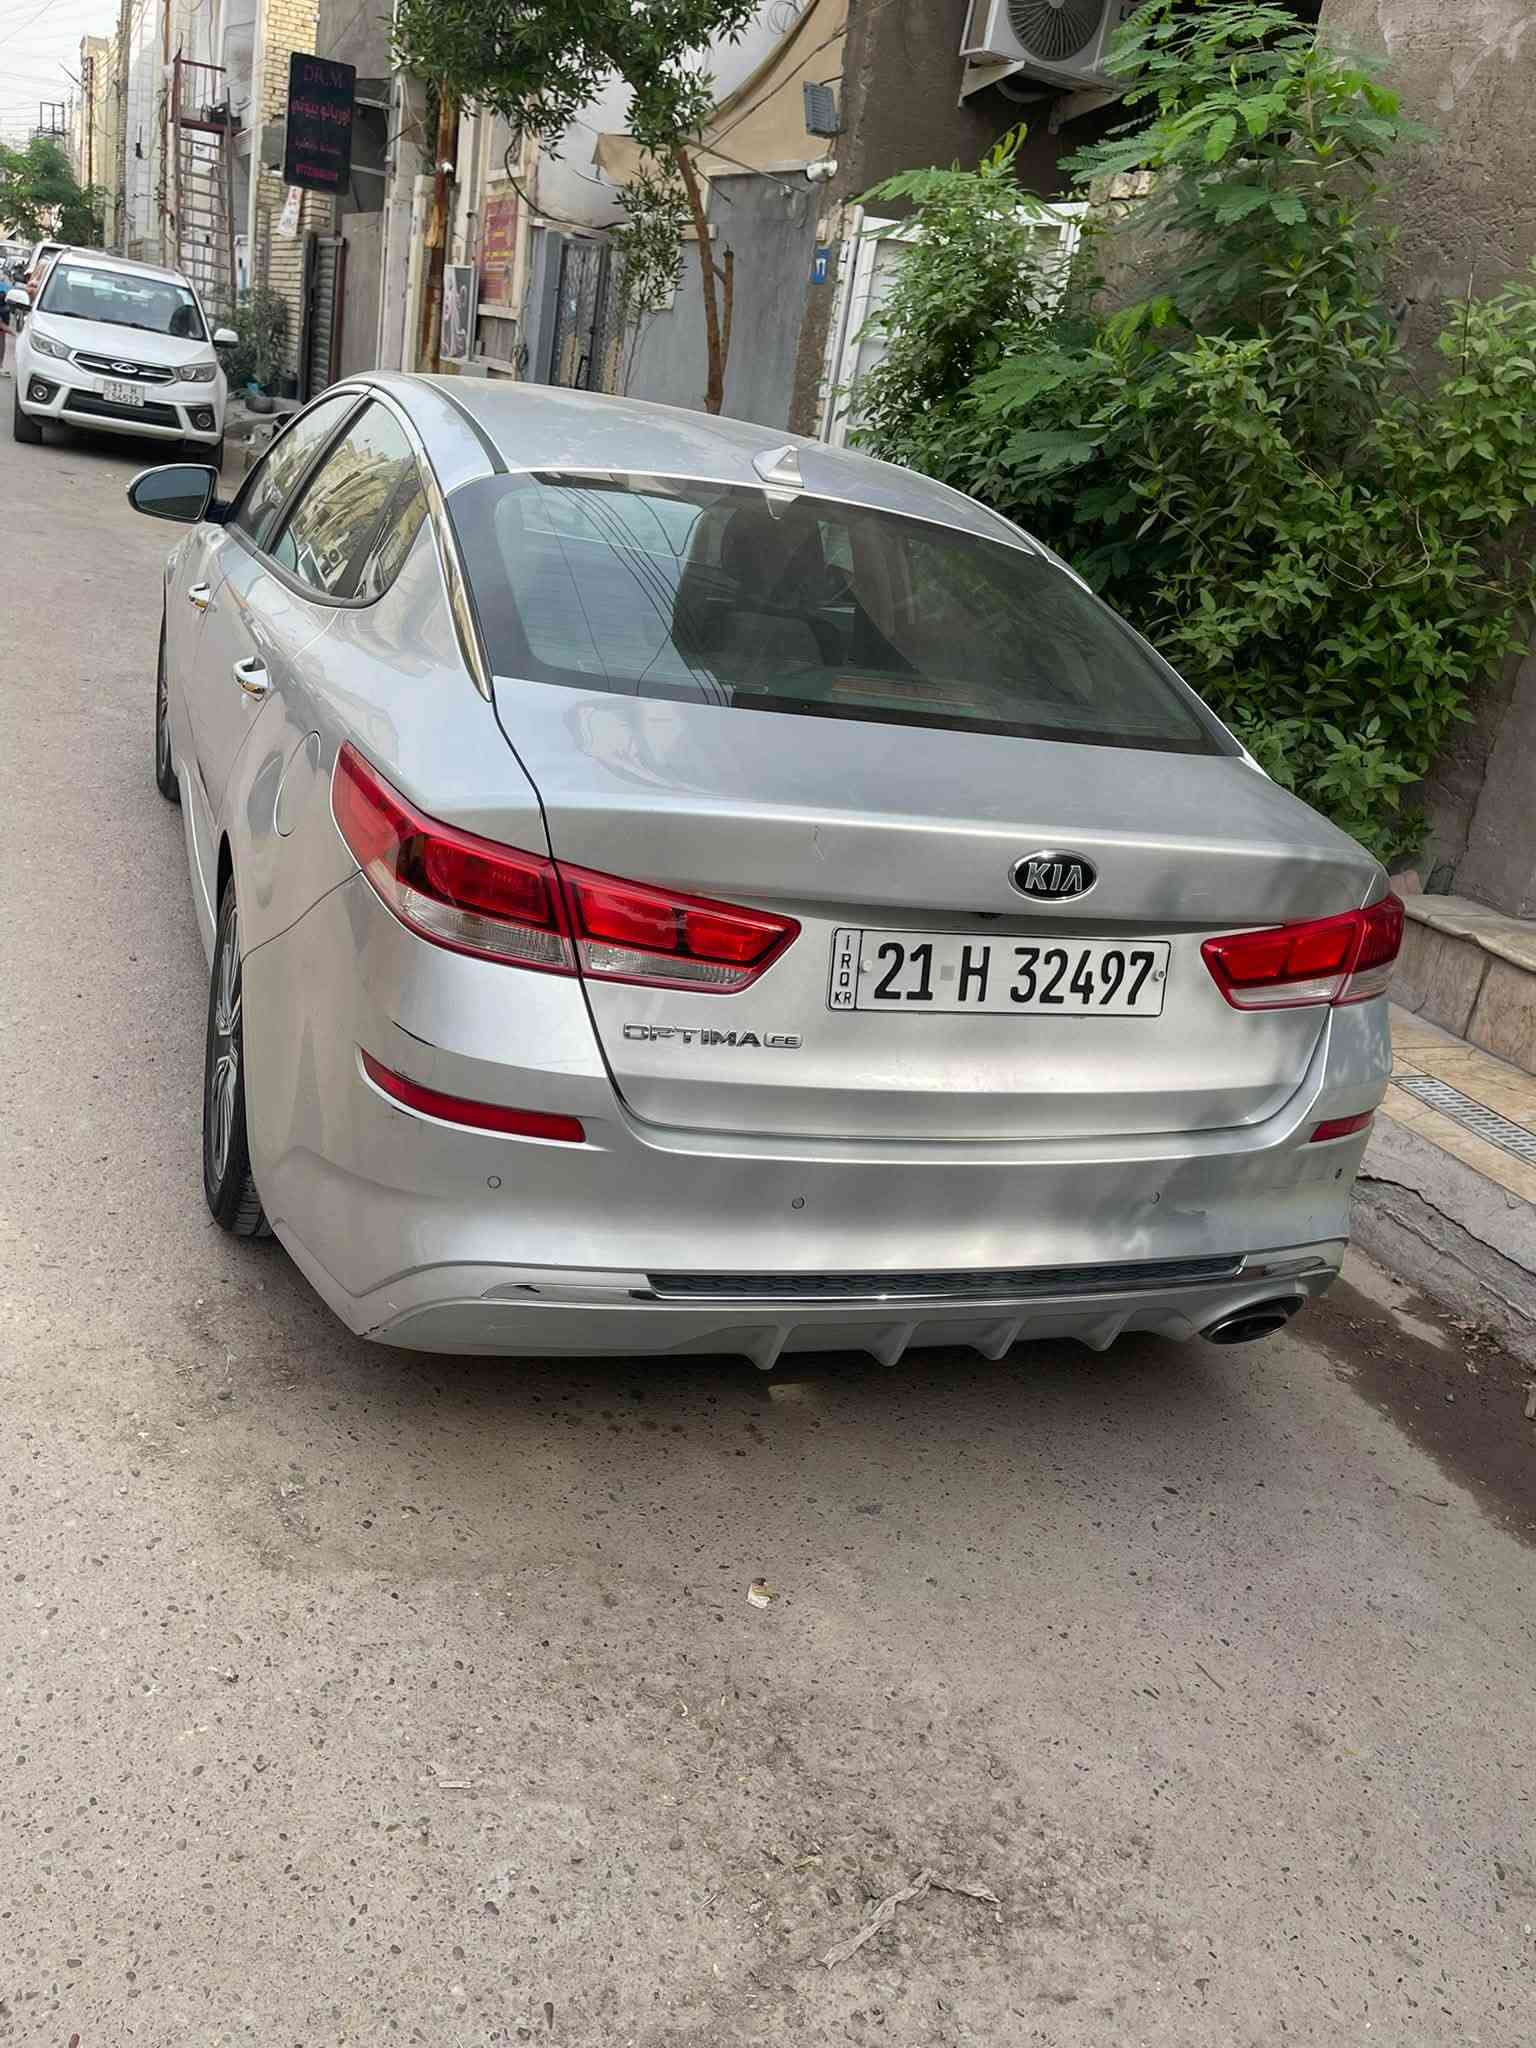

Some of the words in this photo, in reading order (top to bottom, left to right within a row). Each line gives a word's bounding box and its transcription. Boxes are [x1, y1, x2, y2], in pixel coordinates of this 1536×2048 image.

[1024, 862, 1083, 892] KIA
[874, 942, 933, 1001] 21
[957, 945, 991, 1002] H
[1009, 947, 1155, 1006] 32497
[834, 991, 852, 1004] KR
[623, 1023, 762, 1048] OPTIMA
